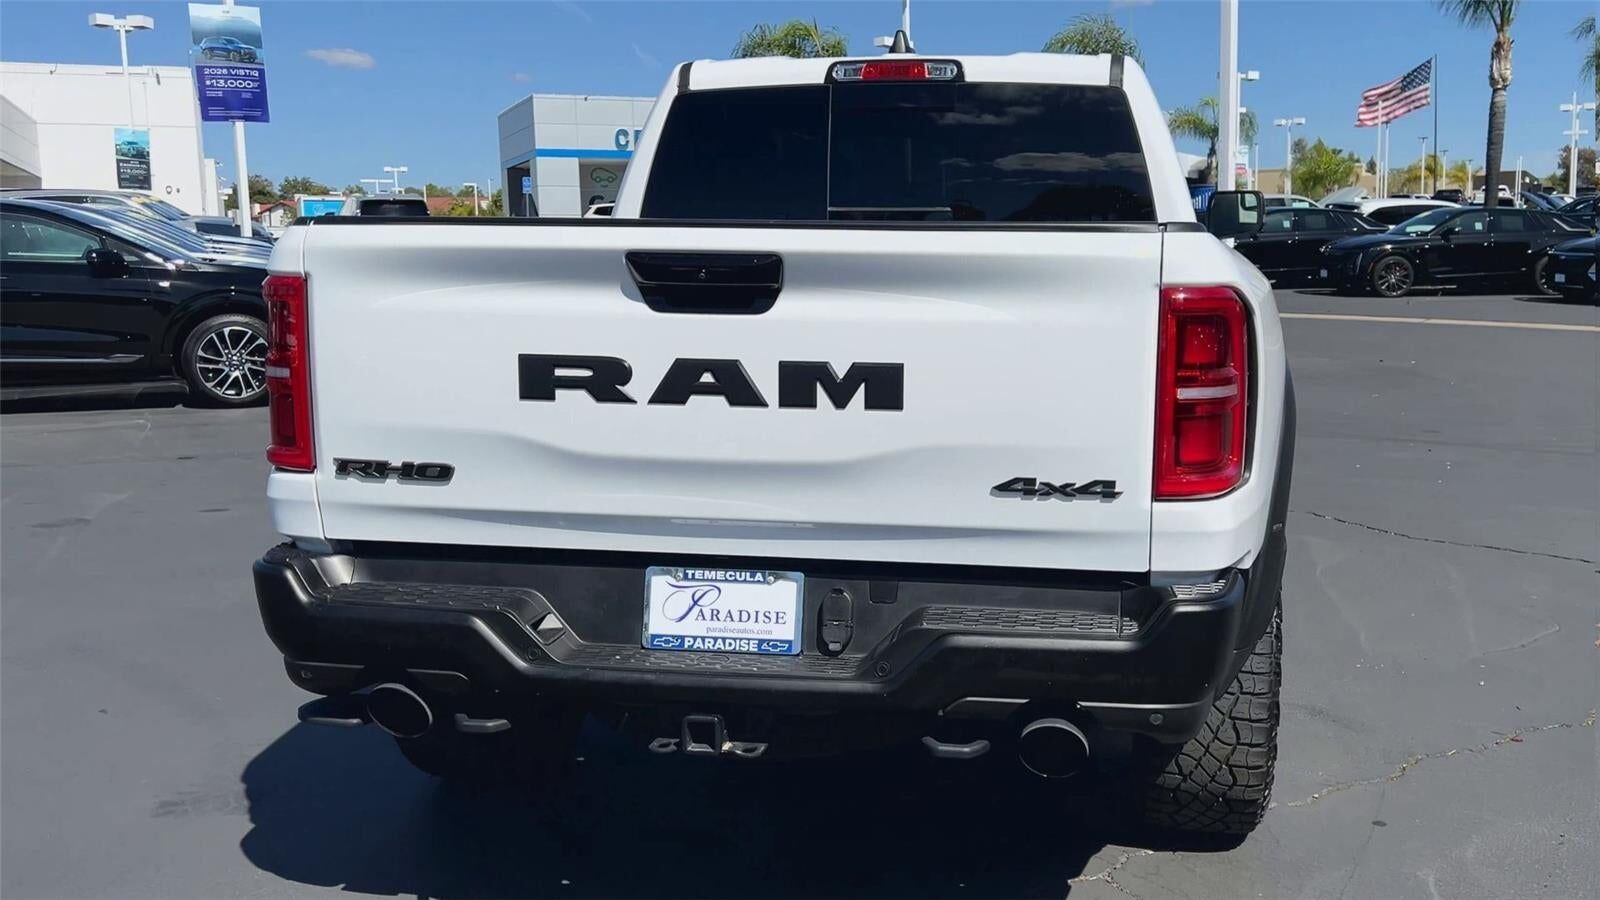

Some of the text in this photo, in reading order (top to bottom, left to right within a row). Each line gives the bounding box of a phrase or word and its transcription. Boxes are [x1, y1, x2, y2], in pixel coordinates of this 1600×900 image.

[229, 69, 259, 77] VISTIQ
[205, 79, 254, 88] $13,000
[518, 353, 904, 411] RAM
[333, 457, 455, 484] RHO
[991, 477, 1123, 501] 4x4
[685, 570, 764, 582] TEMECULA
[706, 625, 773, 636] paradiseautos.com
[684, 637, 759, 651] PARADISE
